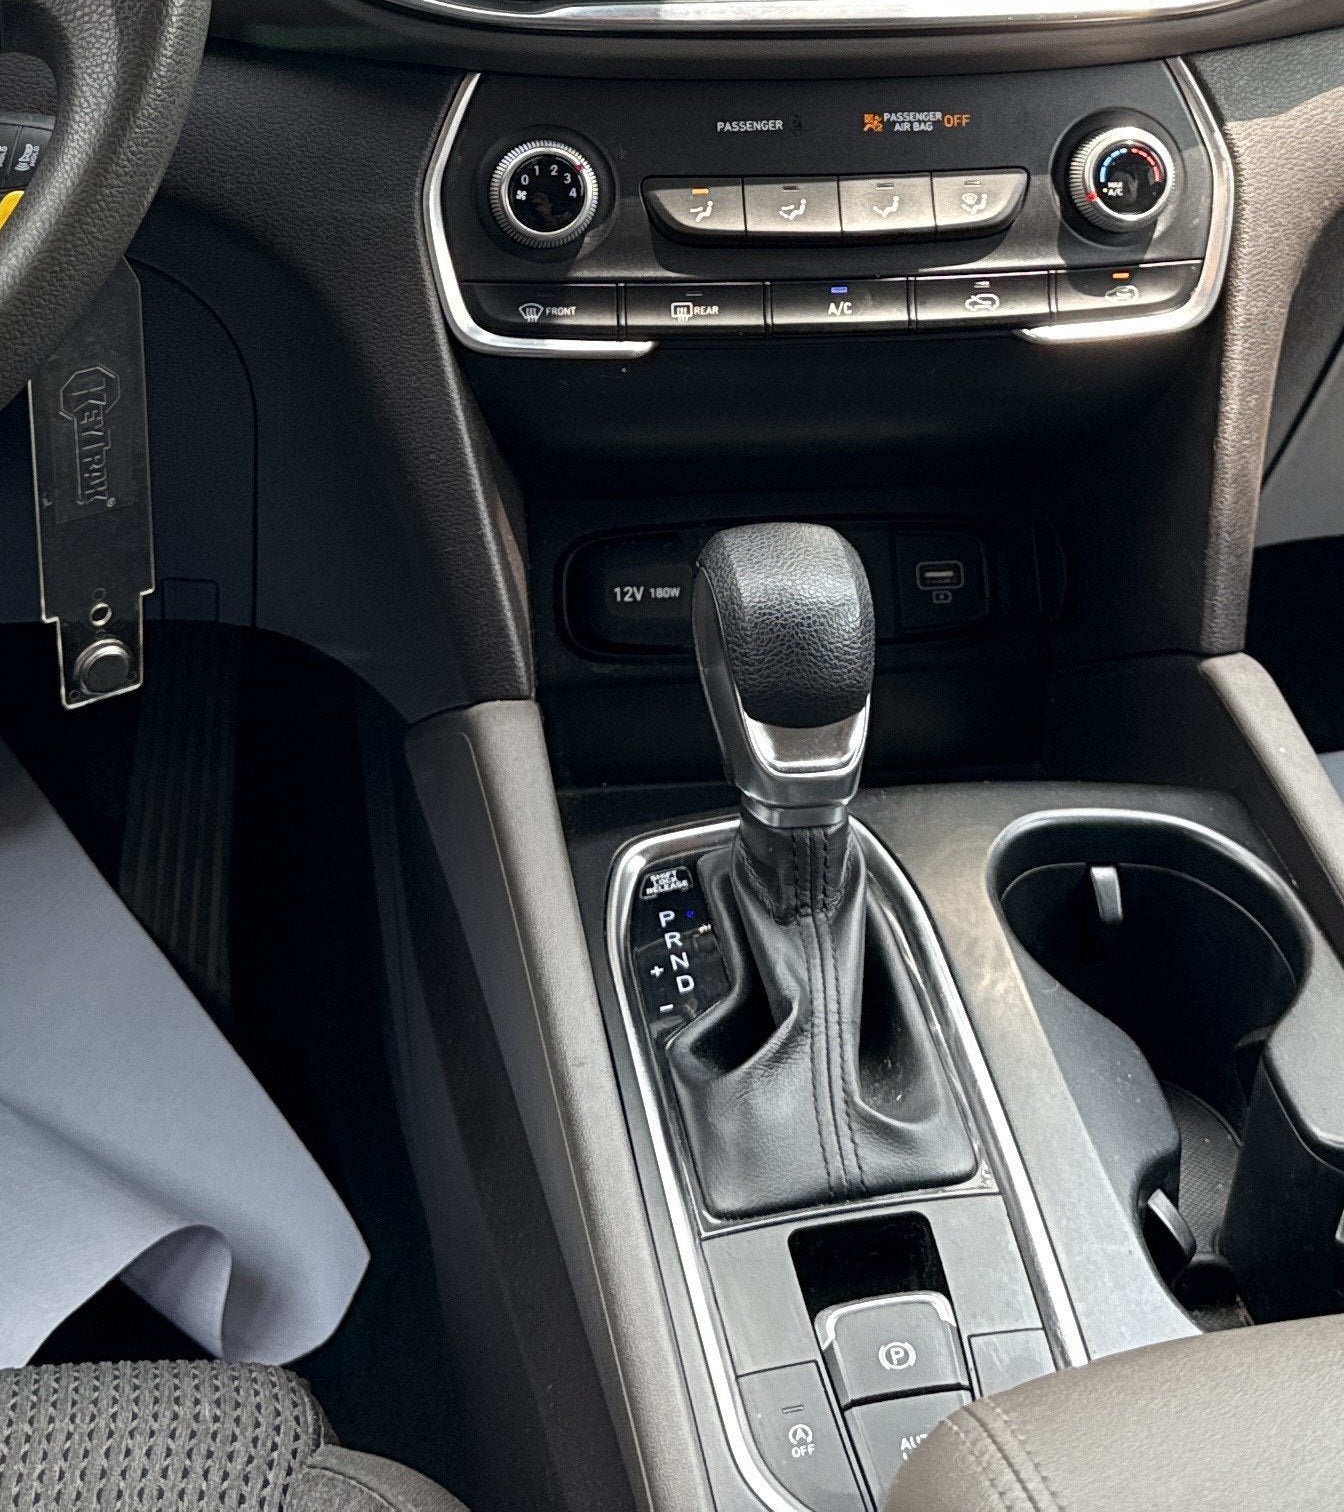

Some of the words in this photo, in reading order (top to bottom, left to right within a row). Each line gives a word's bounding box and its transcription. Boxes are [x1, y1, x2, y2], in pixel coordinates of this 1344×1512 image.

[883, 111, 943, 122] PASSENGER
[943, 114, 971, 128] OFF
[716, 120, 784, 133] PASSENGER
[893, 122, 912, 132] AIR
[912, 122, 934, 132] BAG
[533, 165, 540, 177] 1
[549, 164, 559, 176] 2
[520, 174, 530, 185] 0
[563, 172, 572, 184] 3
[568, 187, 577, 198] 4
[1107, 188, 1124, 197] A/C
[545, 305, 577, 316] FRONT
[693, 304, 719, 316] REAR
[827, 302, 853, 316] A/C
[613, 585, 645, 602] 12V
[649, 586, 681, 599] 180W
[659, 910, 675, 928] P
[664, 931, 684, 949] R
[670, 951, 690, 971] N
[676, 974, 695, 993] D
[790, 1442, 816, 1458] OFF
